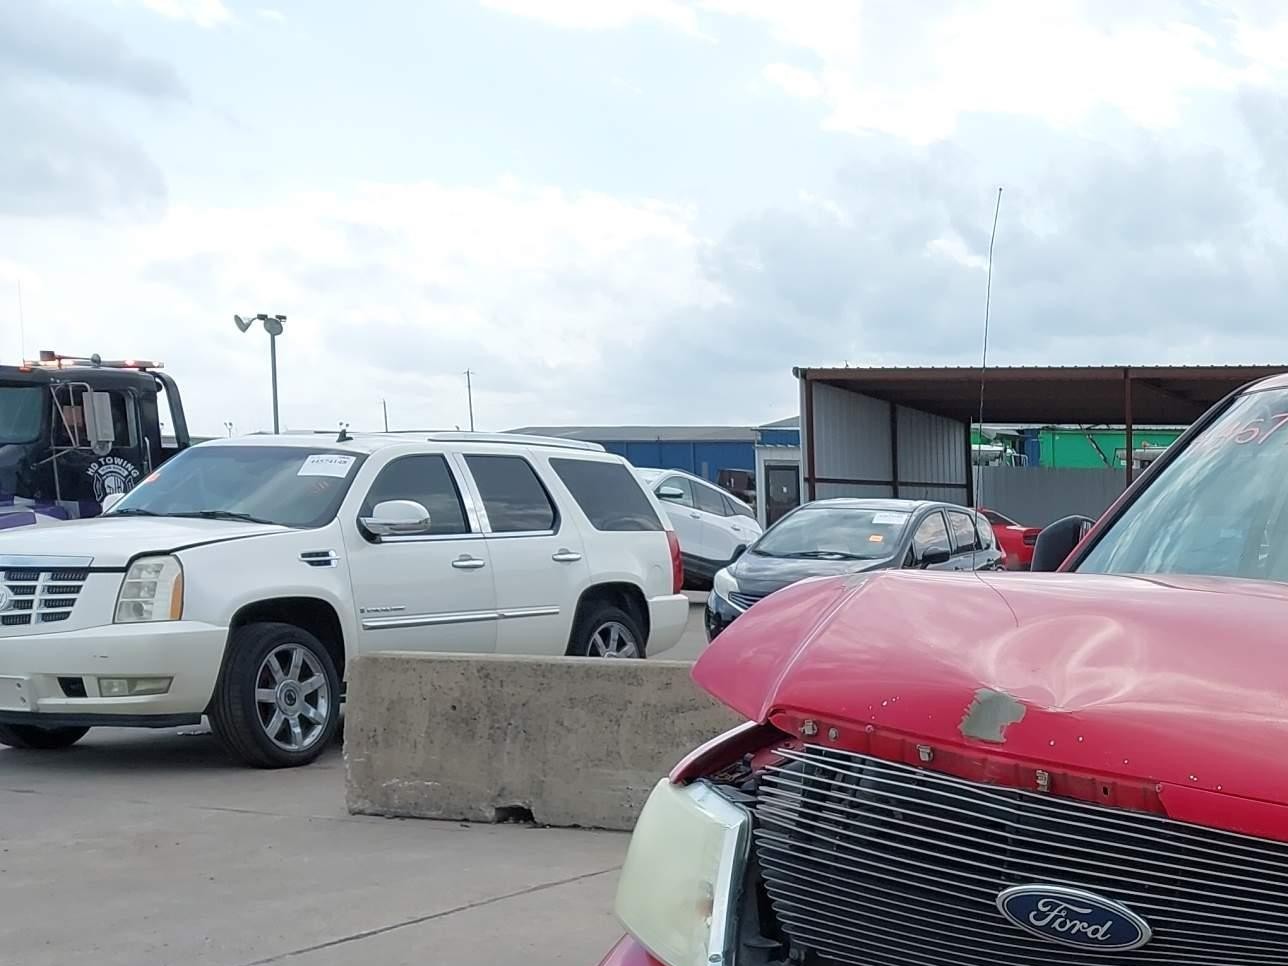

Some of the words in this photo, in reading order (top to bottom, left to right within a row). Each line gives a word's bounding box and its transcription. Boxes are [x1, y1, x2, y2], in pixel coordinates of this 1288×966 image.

[86, 462, 99, 476] HD
[98, 456, 140, 477] TOWING
[1028, 898, 1113, 941] Ford
